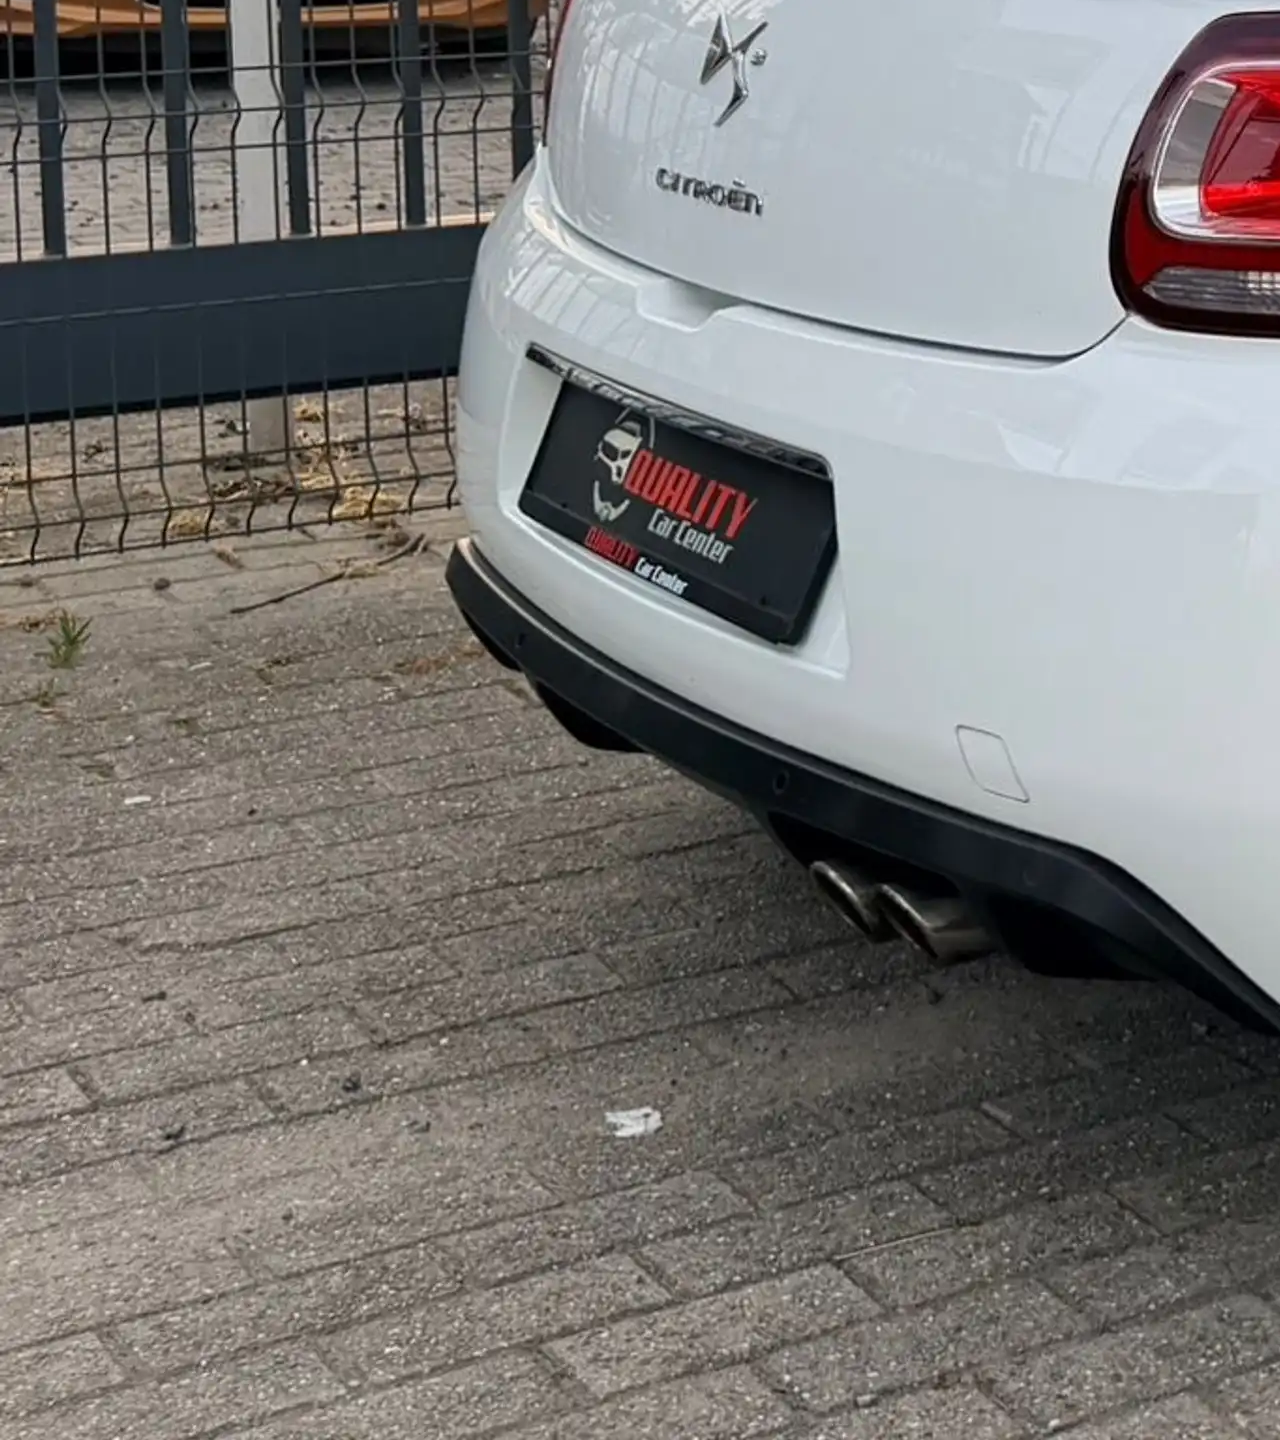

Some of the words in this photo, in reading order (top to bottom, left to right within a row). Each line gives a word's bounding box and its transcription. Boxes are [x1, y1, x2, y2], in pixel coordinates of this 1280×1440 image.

[623, 448, 758, 540] QUALITY
[647, 508, 677, 540] Car
[674, 521, 735, 564] Center
[633, 556, 656, 579] Car
[651, 565, 688, 596] Center
